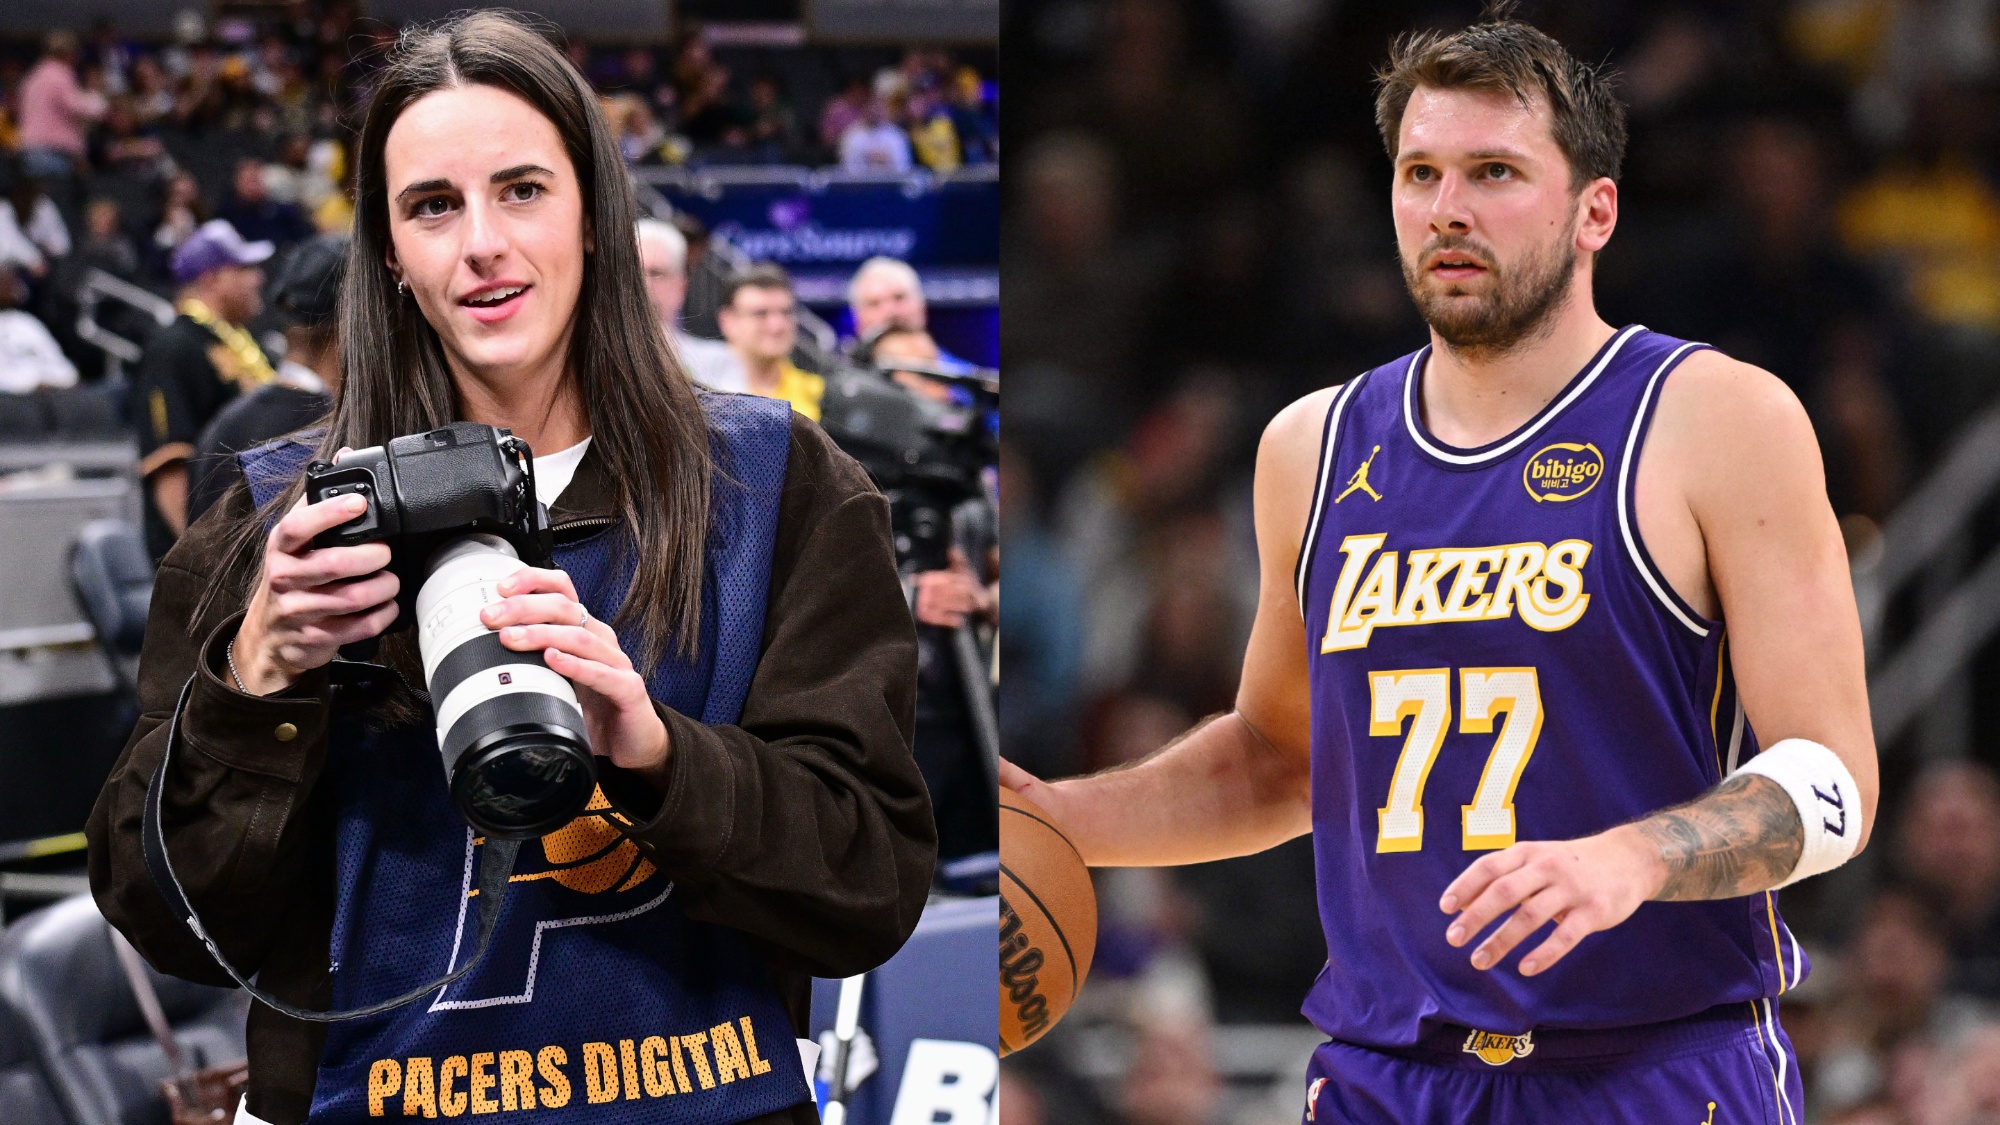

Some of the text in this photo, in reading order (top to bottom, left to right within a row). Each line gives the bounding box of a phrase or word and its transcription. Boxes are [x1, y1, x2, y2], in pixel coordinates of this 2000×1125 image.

[1532, 459, 1599, 484] bibigo
[1541, 479, 1569, 489] 비비고
[1321, 532, 1592, 654] LAKERS
[1368, 667, 1544, 853] 77
[368, 1015, 771, 1118] PACERS DIGITAL
[889, 1038, 999, 1125] B
[1467, 1030, 1533, 1056] LAKERS
